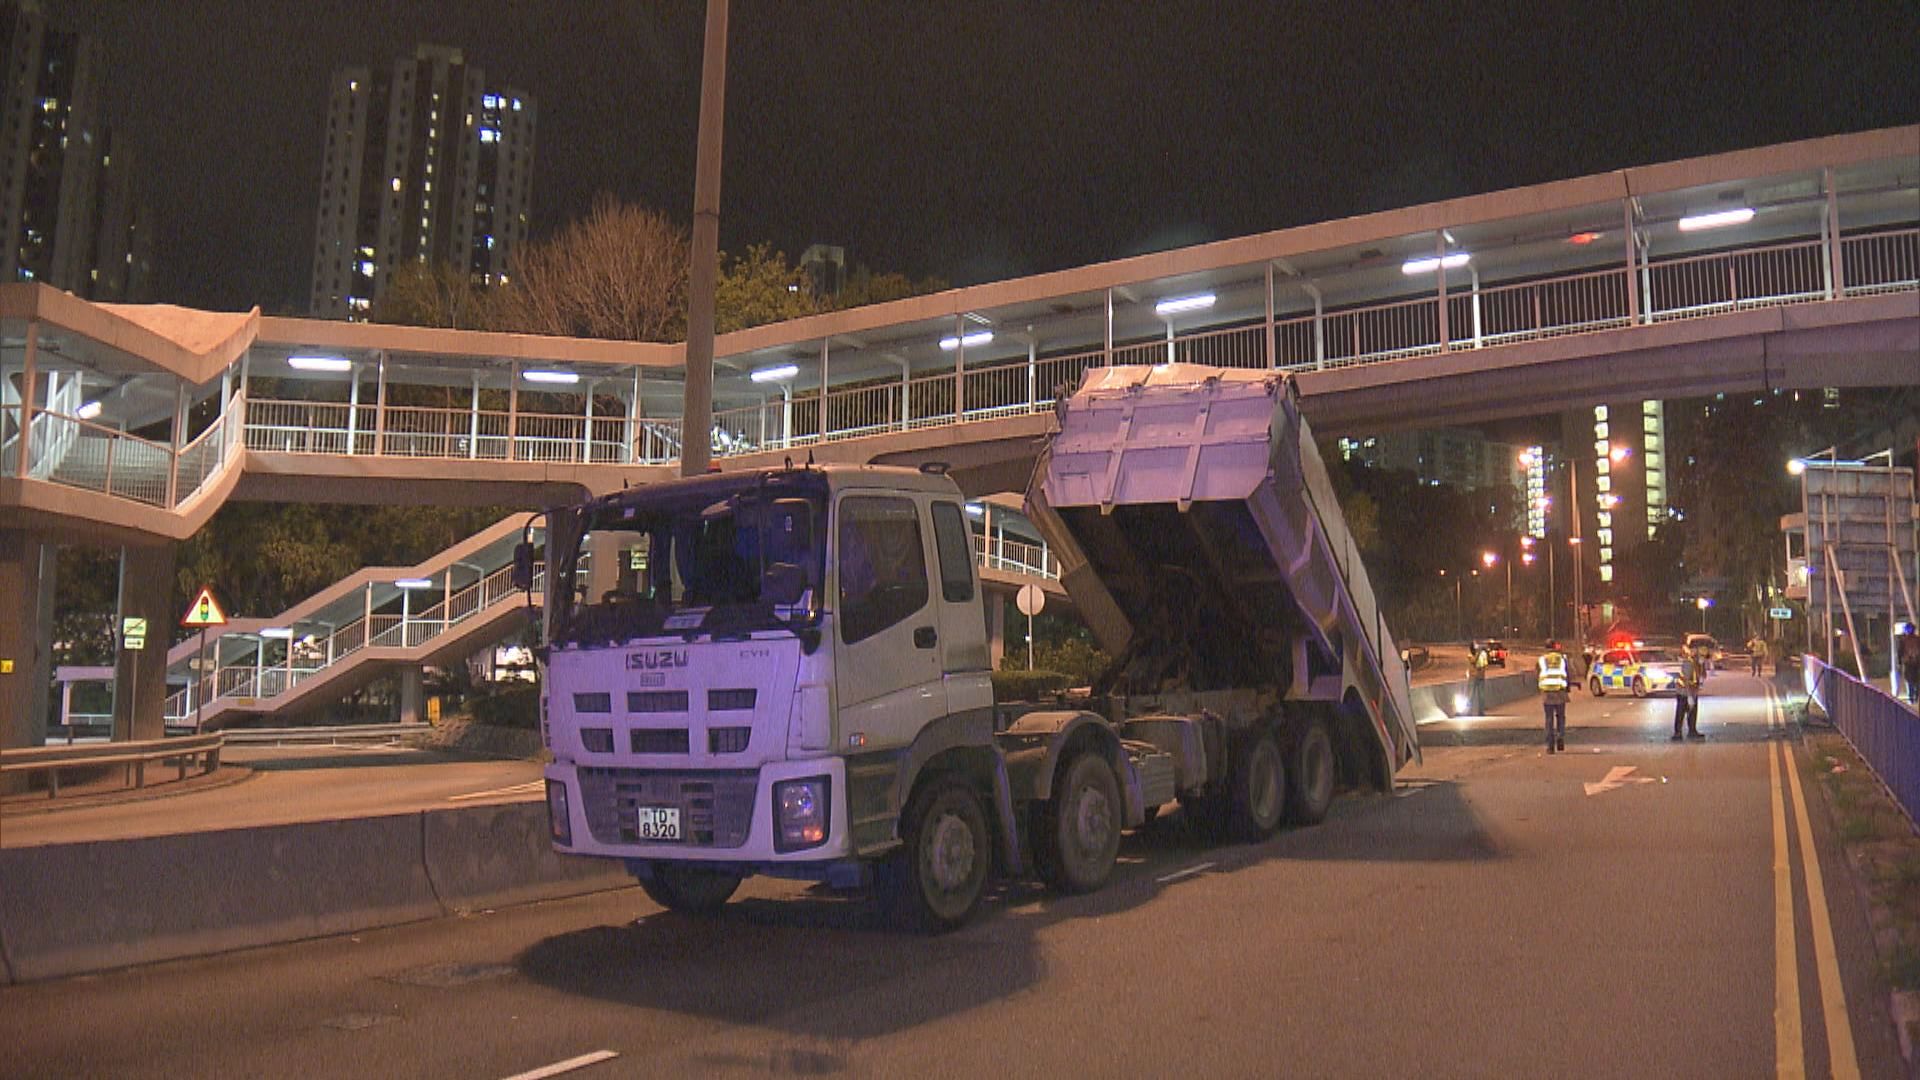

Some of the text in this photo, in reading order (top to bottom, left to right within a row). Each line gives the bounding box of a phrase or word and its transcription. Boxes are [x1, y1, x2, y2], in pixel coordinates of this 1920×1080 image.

[625, 650, 688, 669] ISUZU
[651, 809, 668, 824] TD
[643, 822, 676, 838] 8320
